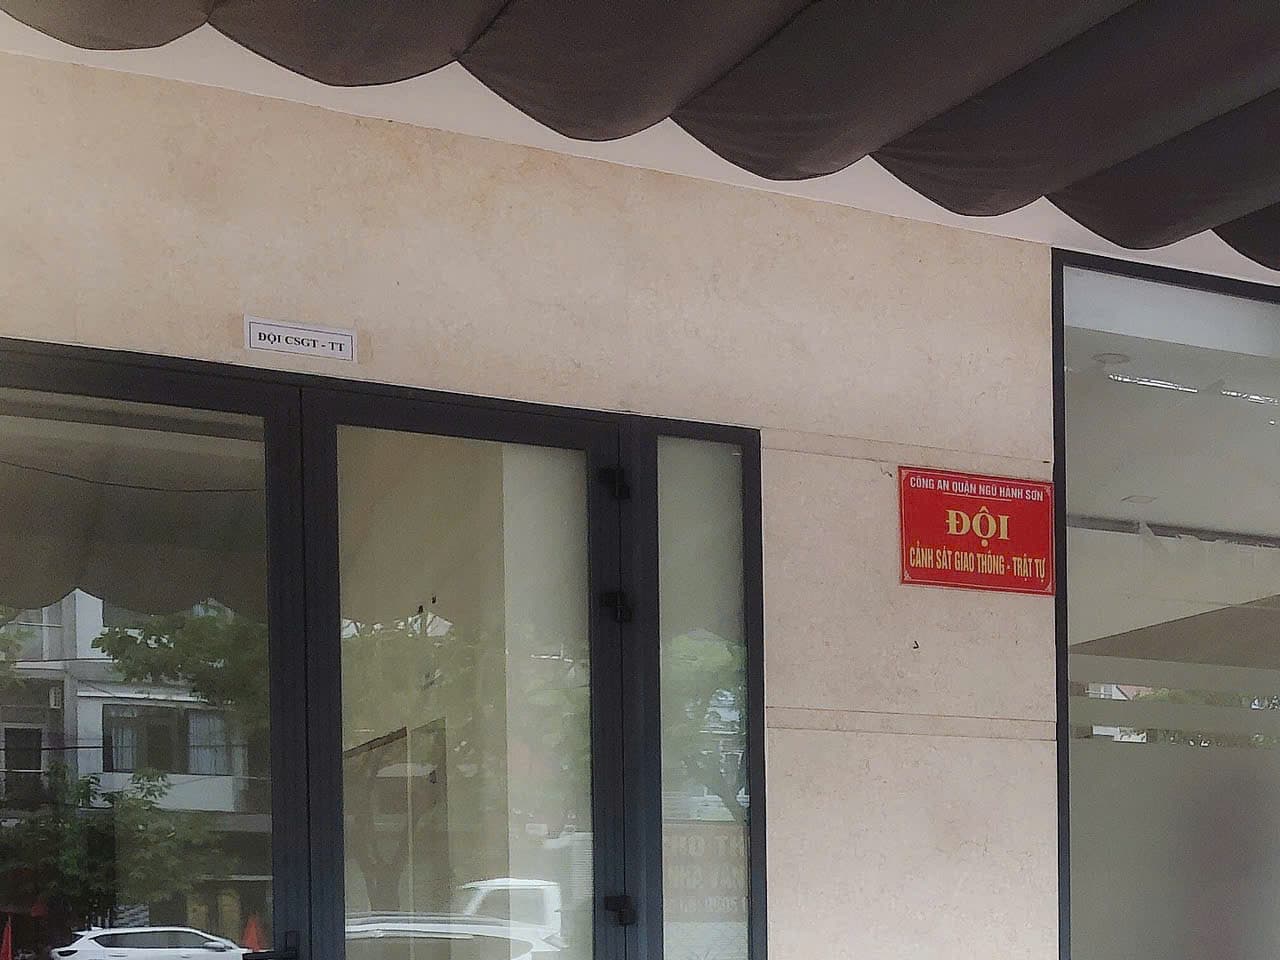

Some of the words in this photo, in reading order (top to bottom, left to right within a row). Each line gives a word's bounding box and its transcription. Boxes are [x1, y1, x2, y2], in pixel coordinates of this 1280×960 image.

[258, 331, 281, 345] ĐỘI
[284, 335, 319, 349] CSGT
[328, 341, 345, 352] TT
[910, 475, 935, 490] CÔNG
[937, 478, 950, 491] AN
[951, 480, 977, 496] QUẬN
[978, 483, 997, 497] NGŨ
[999, 485, 1023, 499] HÀNH
[1025, 489, 1044, 502] SƠN
[945, 505, 1011, 547] ĐỘI
[909, 540, 934, 569] CẢNH
[936, 545, 953, 570] SÁT
[954, 551, 975, 573] GIAO
[976, 550, 1005, 575] THÔNG
[1012, 554, 1033, 582] TRẬT
[1034, 557, 1046, 583] TỰ
